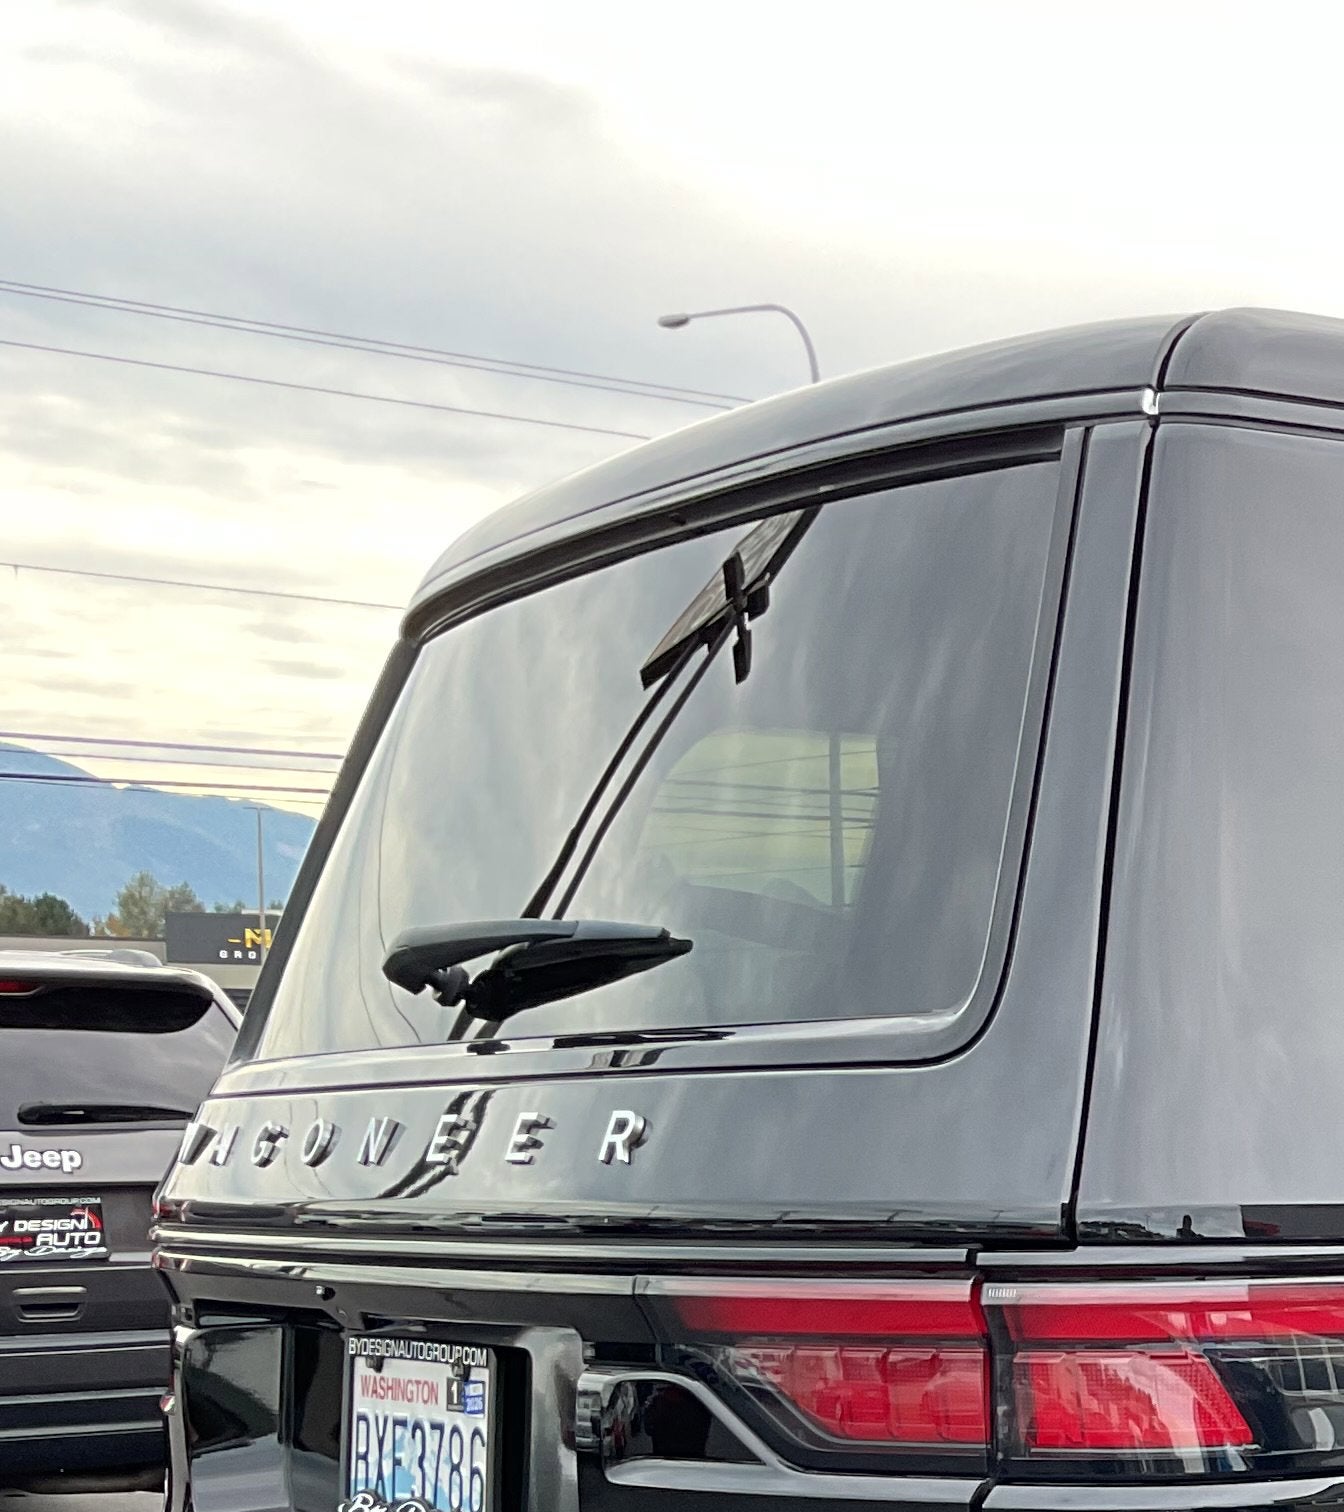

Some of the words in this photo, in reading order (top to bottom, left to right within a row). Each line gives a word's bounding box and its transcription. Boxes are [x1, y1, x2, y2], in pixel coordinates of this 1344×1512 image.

[0, 1143, 82, 1174] Jeep
[14, 1218, 87, 1232] DESIGN
[36, 1231, 101, 1247] AUTO
[360, 1375, 439, 1405] WASHINGTON
